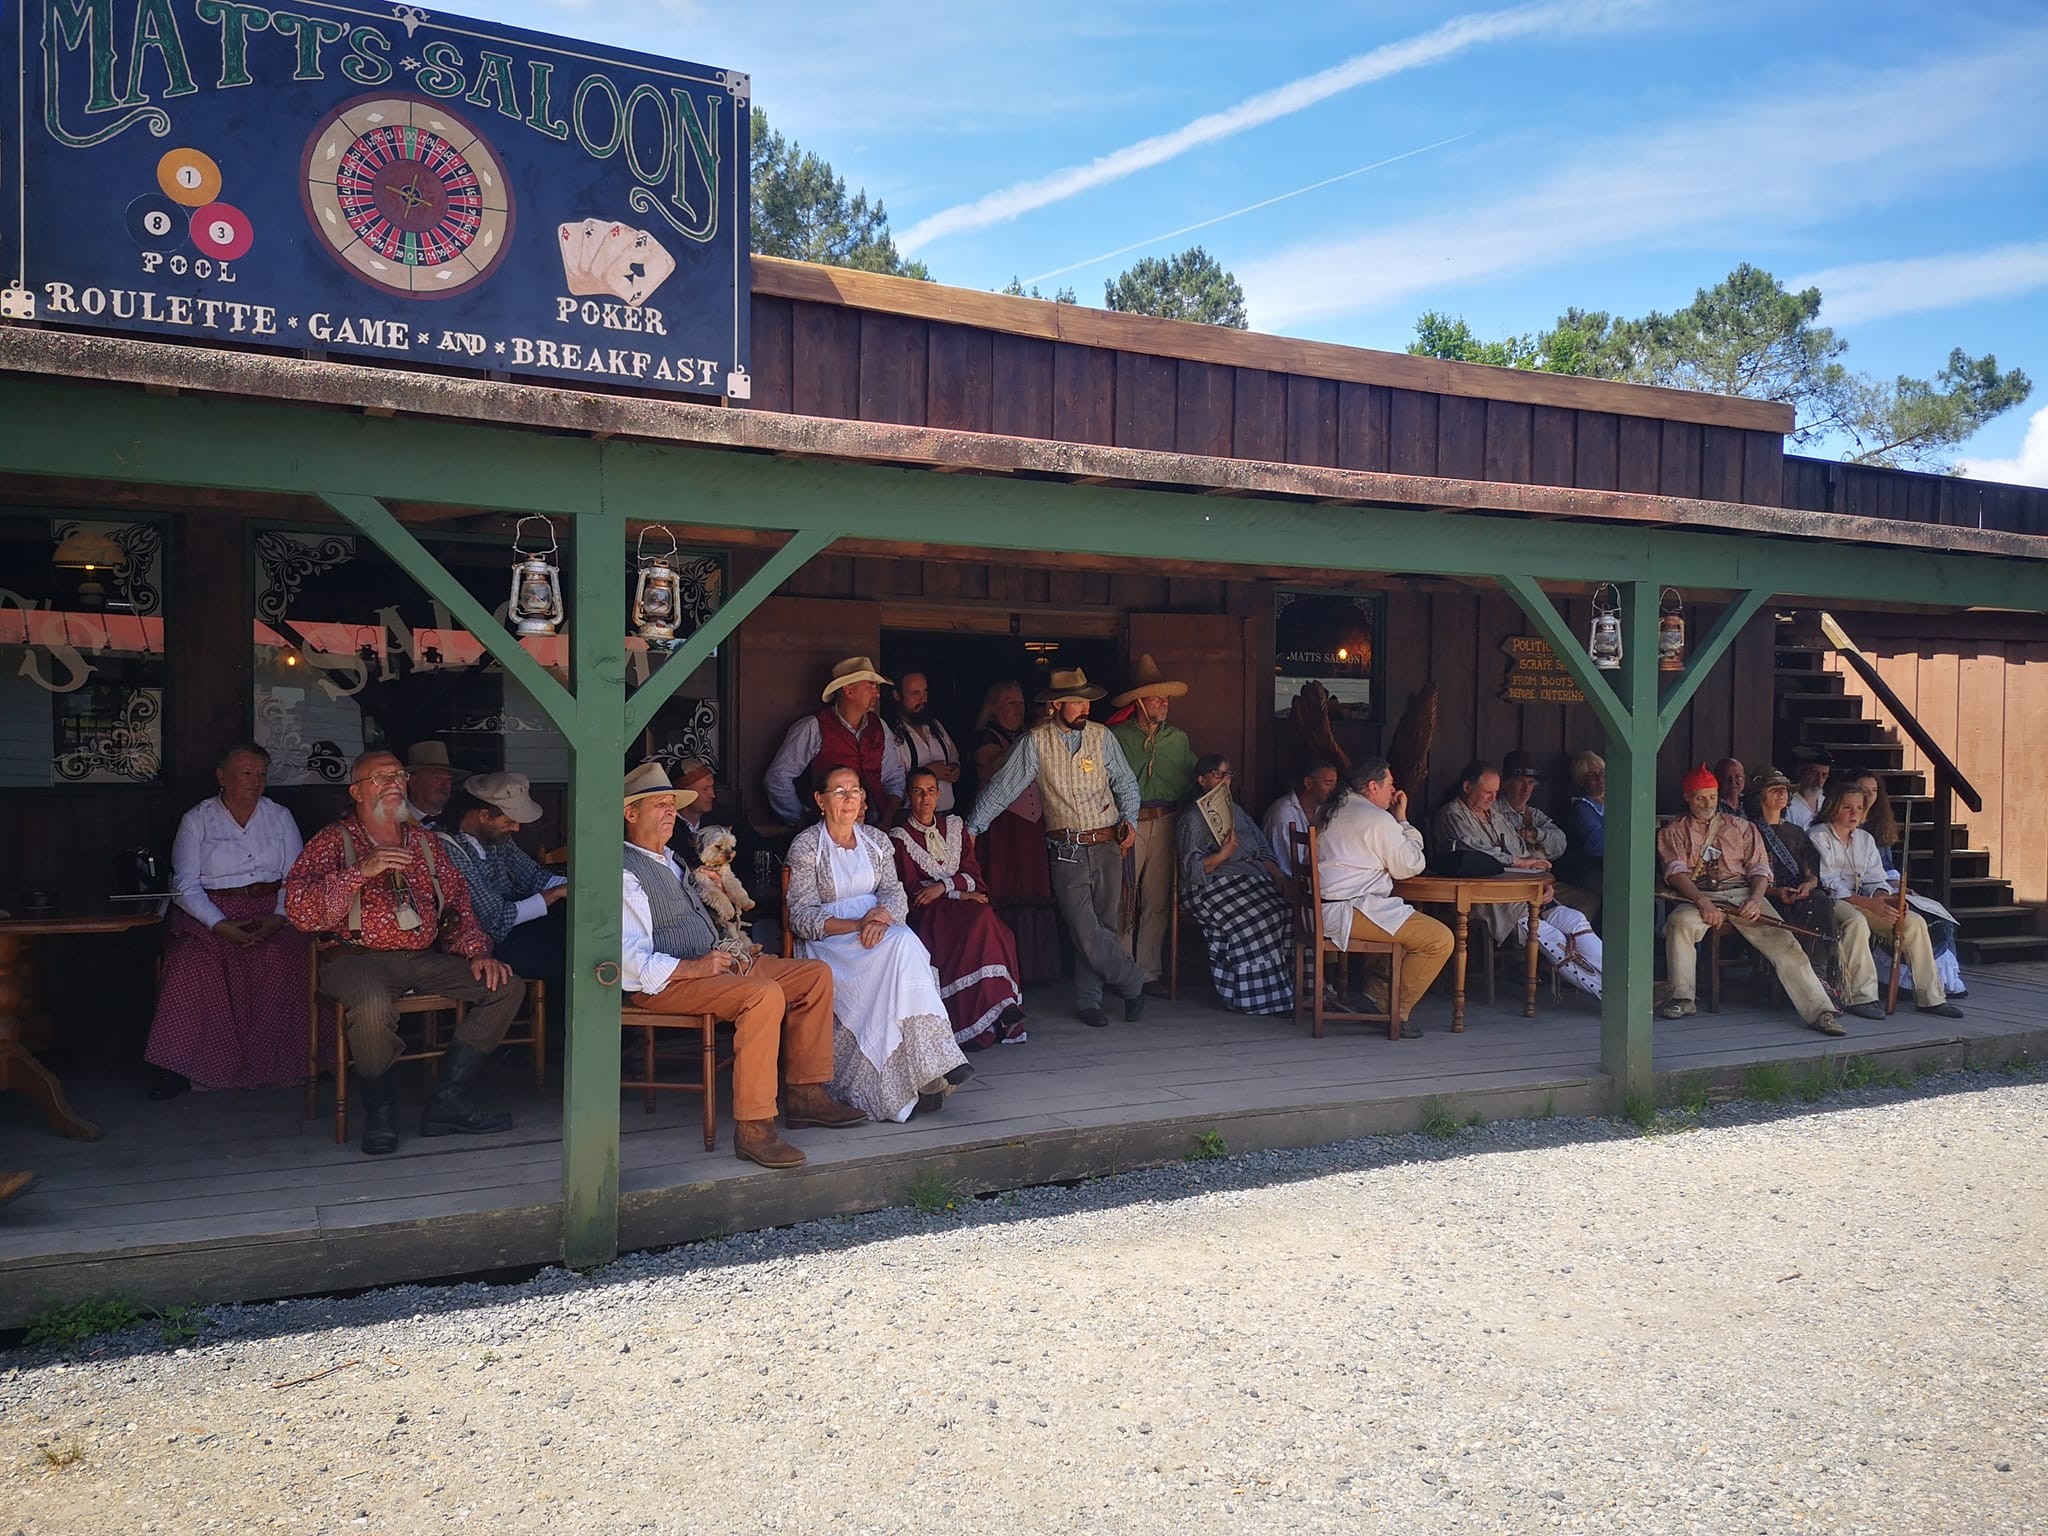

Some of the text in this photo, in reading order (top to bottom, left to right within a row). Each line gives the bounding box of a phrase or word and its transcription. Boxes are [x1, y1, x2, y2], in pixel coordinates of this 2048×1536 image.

[40, 0, 722, 243] MATT'S SALOON
[185, 170, 192, 184] 1
[152, 216, 163, 230] 8
[217, 227, 225, 239] 3
[141, 251, 237, 283] POOL
[556, 296, 667, 336] POKER
[44, 281, 718, 386] ROULETTE GAME AND BREAKFAST
[1512, 638, 1553, 653] POLITIC
[1519, 658, 1553, 671] SCRAPE
[1512, 675, 1575, 687] FROM BOOTS
[1508, 687, 1584, 701] BEFORE ENTERING
